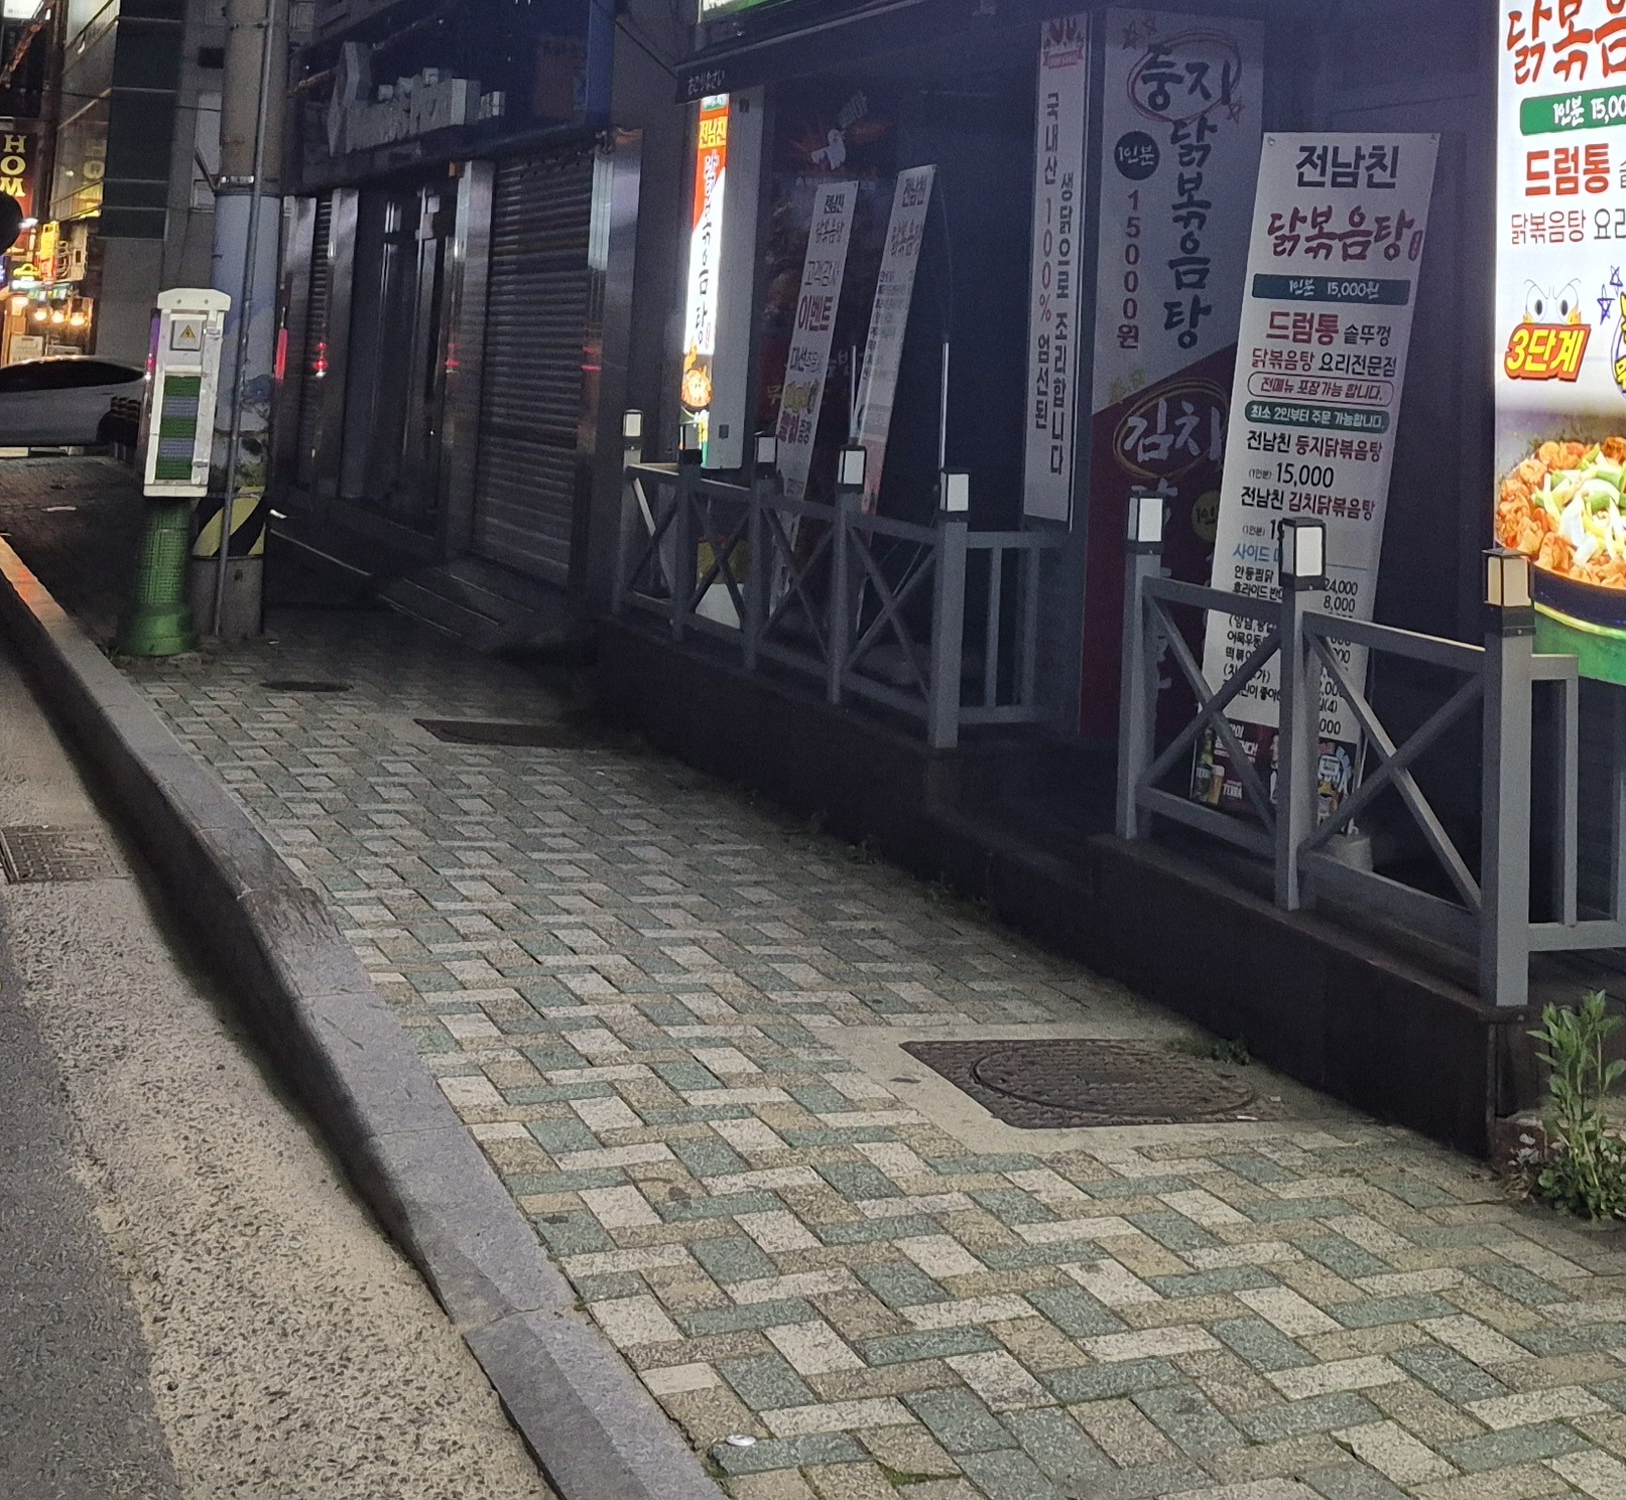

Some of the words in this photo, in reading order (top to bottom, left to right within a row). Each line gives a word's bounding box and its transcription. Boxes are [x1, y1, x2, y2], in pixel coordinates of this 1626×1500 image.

[1139, 43, 1232, 112] 둥지
[1552, 100, 1585, 128] 1인분
[1045, 92, 1060, 186] 국내산
[1118, 144, 1155, 166] 1인분
[1294, 144, 1399, 190] 전남친
[1525, 143, 1611, 197] 드럼통
[1163, 116, 1219, 350] 닭볶음탕
[1267, 204, 1415, 262] 닭볶음탕
[1510, 208, 1587, 246] 닭볶음탕
[1039, 196, 1054, 323] 100%
[1116, 189, 1142, 350] 15000원
[1288, 278, 1315, 295] 1인분
[1326, 280, 1380, 299] 15,000원
[797, 294, 834, 332] 이벤트
[1265, 310, 1340, 346] 드럼통
[1343, 323, 1392, 348] 솥뚜껑
[1251, 347, 1316, 373] 닭볶음탕
[1317, 352, 1398, 378] 요리전문점
[1505, 327, 1586, 376] 3단계
[1035, 334, 1051, 430] 엄선된
[1050, 312, 1069, 476] 조리합니다
[1260, 376, 1295, 393] 전메뉴
[1297, 379, 1344, 397] 포장가능
[1344, 383, 1383, 401] 합니다.
[1123, 396, 1222, 464] 김치
[1250, 404, 1272, 419] 최소
[1273, 406, 1310, 423] 2인부터
[1311, 409, 1332, 425] 주문
[1334, 411, 1385, 429] 가능합니다.
[1246, 429, 1292, 454] 전남친
[1295, 434, 1383, 463] 둥지닭볶음탕
[1276, 461, 1335, 489] 15,000
[1240, 485, 1285, 511] 전남친
[1288, 492, 1376, 522] 김치닭볶음탕
[1232, 542, 1271, 563] 사이드
[1234, 564, 1275, 583] 안동찜닭
[1323, 594, 1356, 613] 8,000
